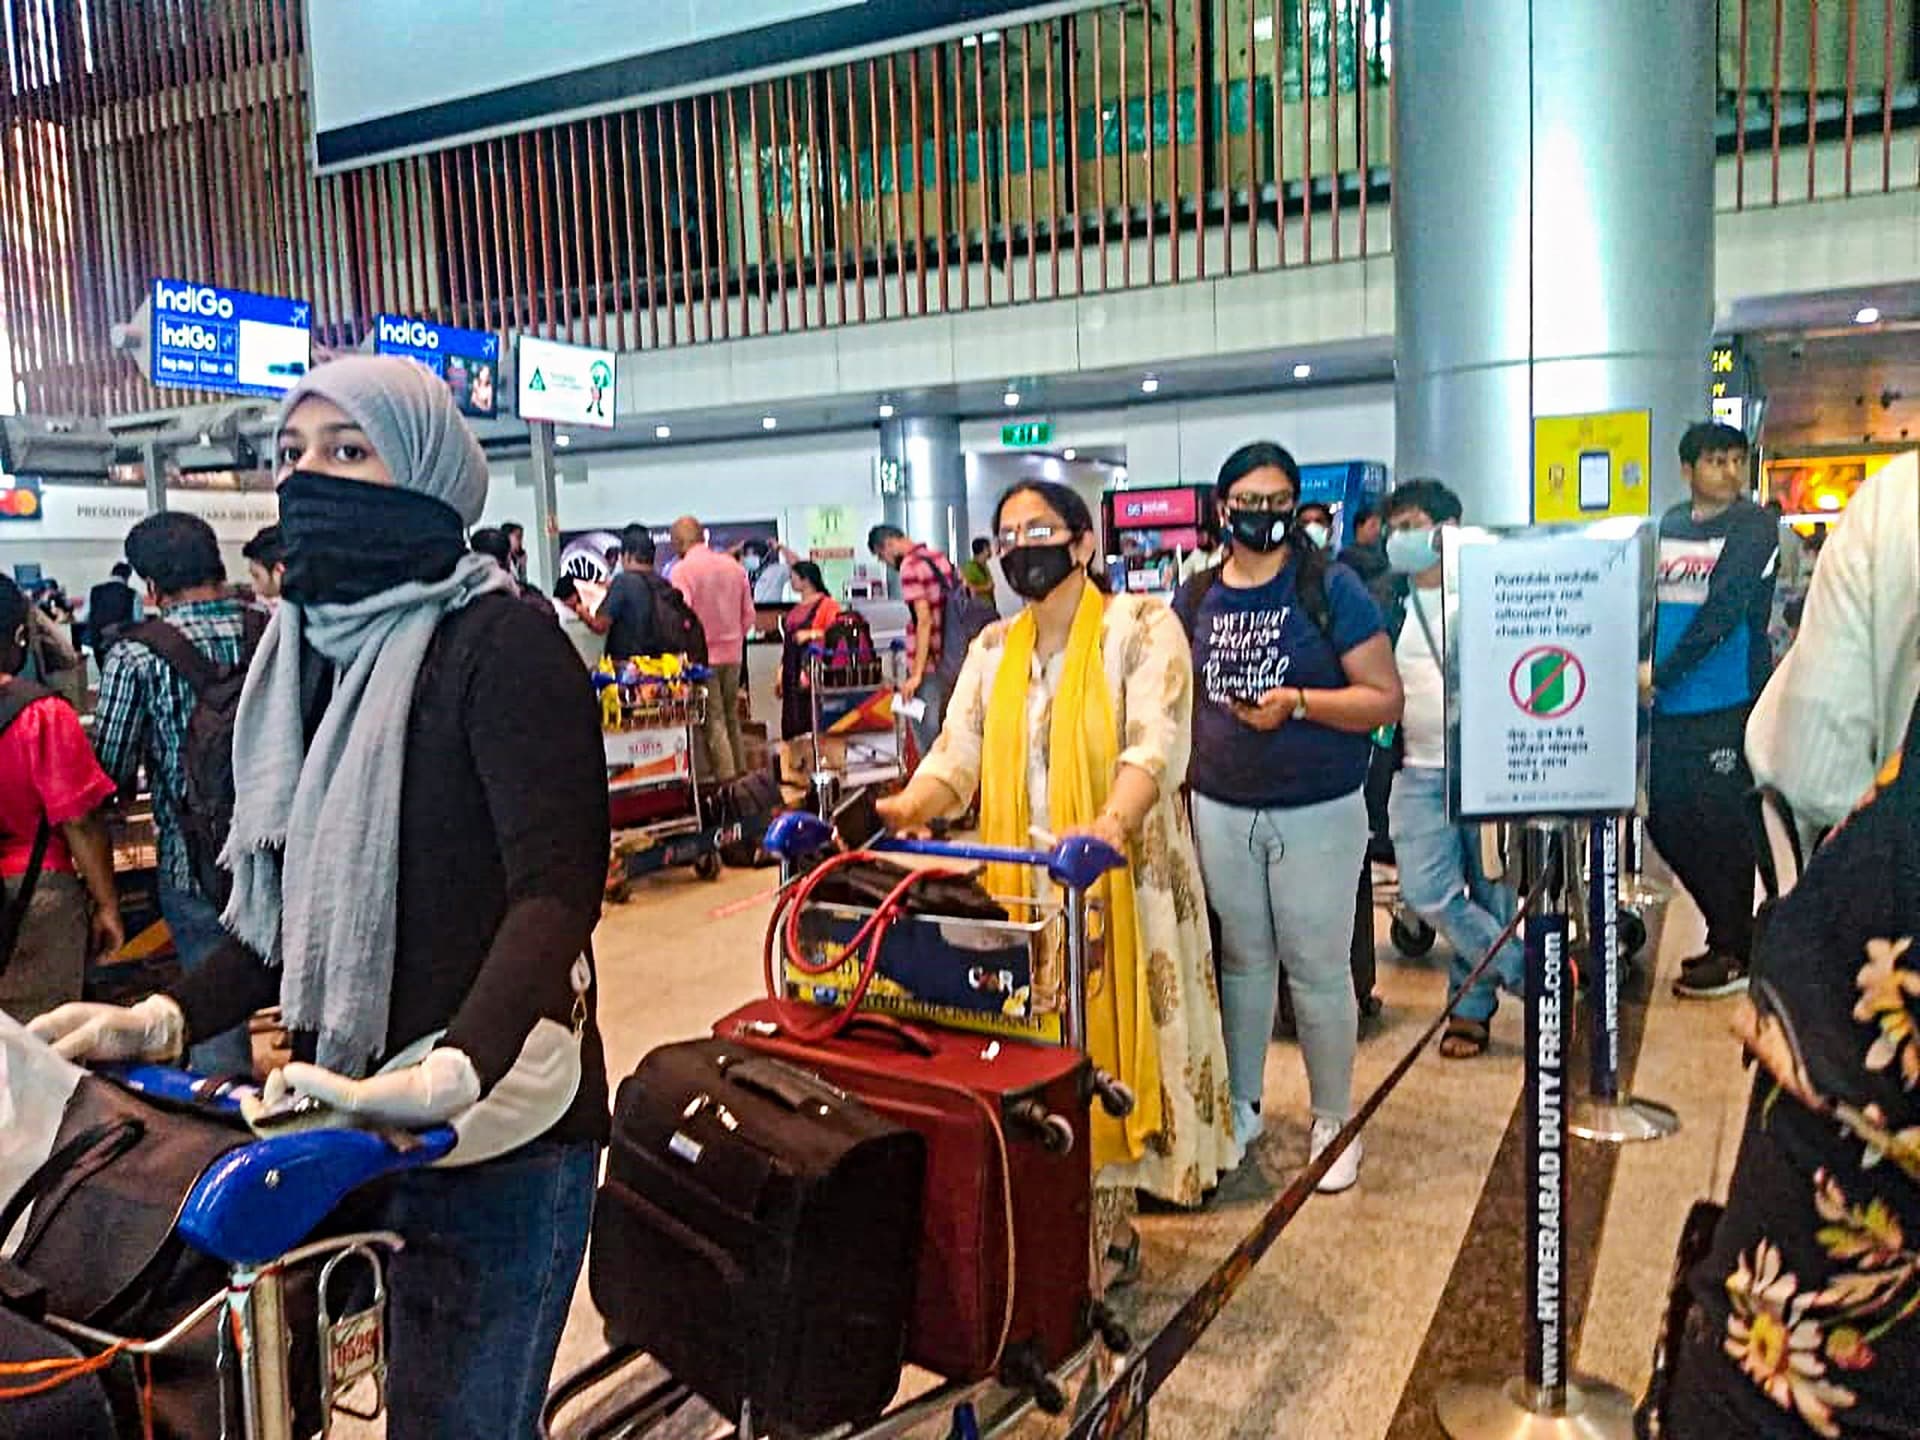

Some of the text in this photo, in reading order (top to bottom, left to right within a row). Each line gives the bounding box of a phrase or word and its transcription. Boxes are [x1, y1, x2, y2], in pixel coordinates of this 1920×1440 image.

[156, 280, 233, 319] IndiGo
[161, 321, 216, 351] IndiGo
[379, 316, 438, 349] IndiGo
[77, 504, 144, 518] PRESENTIN
[1495, 588, 1583, 605] chargers not
[1495, 605, 1567, 621] allowed in
[1555, 622, 1593, 638] bags
[1202, 655, 1290, 693] Beautiful
